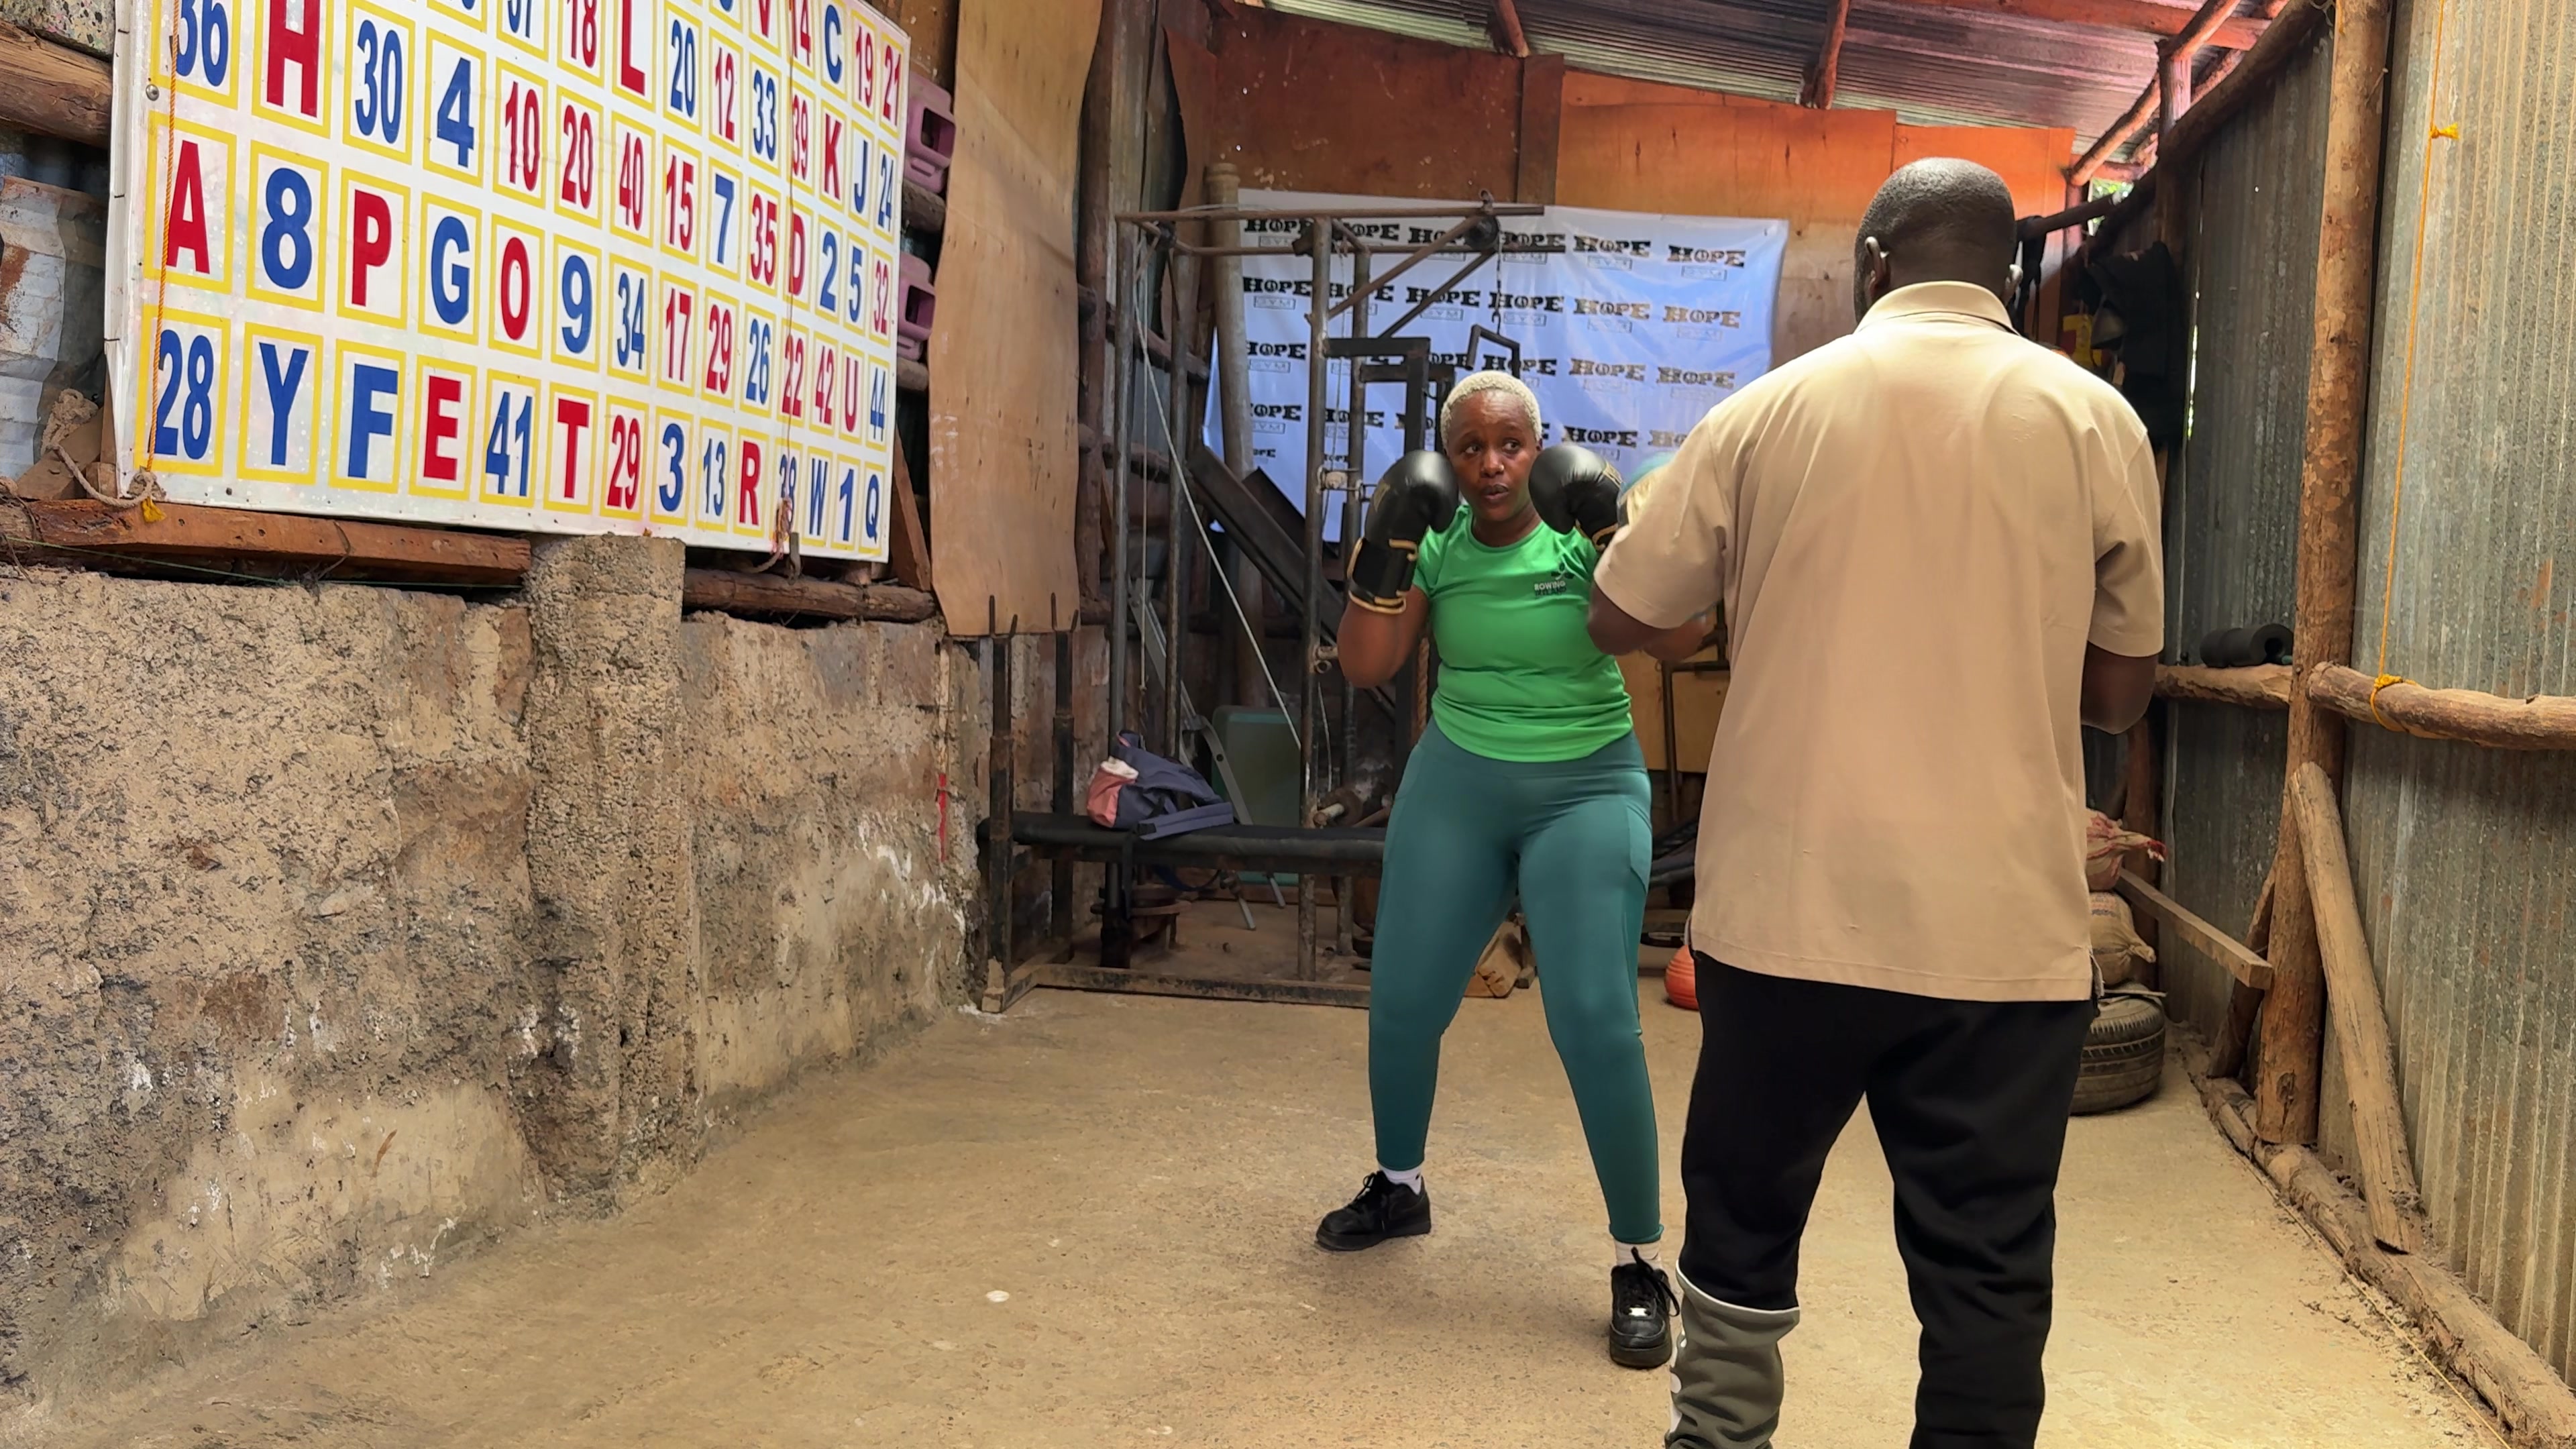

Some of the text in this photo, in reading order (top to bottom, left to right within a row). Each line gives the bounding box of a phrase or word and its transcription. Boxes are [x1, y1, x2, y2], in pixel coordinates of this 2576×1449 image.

[789, 0, 811, 66] 14
[825, 5, 842, 83] C
[856, 26, 873, 107] 19
[883, 45, 901, 125] 21
[572, 0, 596, 67] 18
[621, 0, 645, 95] L
[671, 20, 695, 117] 20
[716, 48, 734, 141] 12
[753, 70, 775, 160] 33
[792, 94, 808, 181] 39
[824, 113, 841, 199] K
[855, 140, 867, 213] J
[878, 154, 893, 231] 24
[169, 0, 888, 335] 36 H 30 4 10 20 40 15 7 35 D 2 5 32
[166, 140, 885, 441] A 8 P G O 9 34 17 29 26 22 42 U 44
[1573, 235, 1651, 257] HOPE
[1667, 245, 1746, 268] HOPE
[1243, 276, 1312, 297] HOPE
[1489, 291, 1564, 313] HOPE
[1573, 298, 1650, 320] HOPE
[1662, 305, 1740, 329] HOPE
[1568, 358, 1646, 382] HOPE
[1656, 367, 1736, 389] HOPE
[148, 330, 214, 460] 28
[259, 342, 309, 466] Y
[347, 364, 398, 478] F
[423, 376, 461, 480] E
[486, 392, 532, 496] 41
[557, 398, 589, 498] T
[607, 415, 640, 510] 29
[659, 423, 684, 511] 3
[704, 439, 725, 516] 13
[739, 441, 761, 525] R
[810, 458, 828, 535] W
[840, 469, 853, 541] 1
[866, 474, 879, 543] Q
[1251, 404, 1301, 421] OPE
[1562, 425, 1638, 448] HOPE
[1648, 430, 1688, 448] HO
[1534, 580, 1566, 591] ROWING
